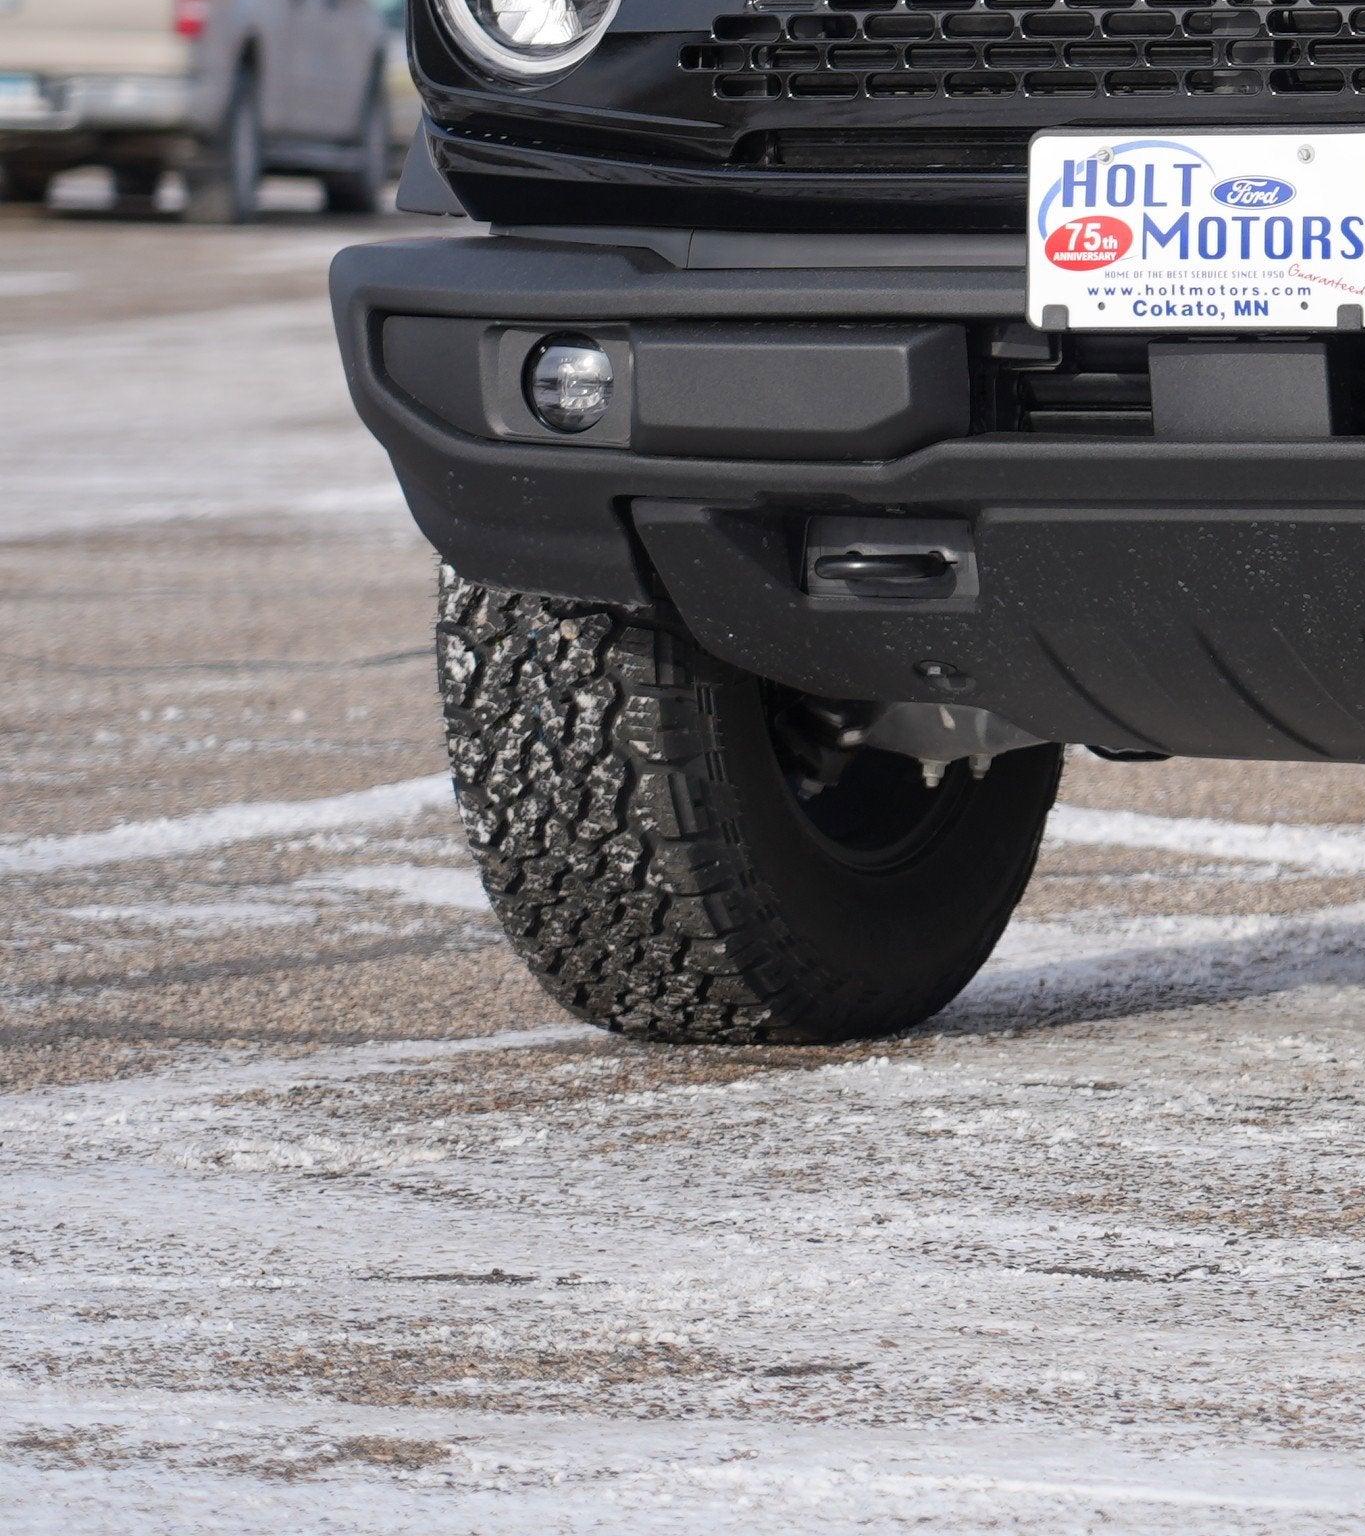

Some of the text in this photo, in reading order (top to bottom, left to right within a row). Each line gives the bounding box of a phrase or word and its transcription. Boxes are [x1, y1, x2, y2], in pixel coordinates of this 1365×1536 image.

[1062, 159, 1202, 208] HOLT
[1226, 179, 1281, 206] Ford
[1065, 222, 1119, 252] 75th
[1142, 211, 1365, 260] MOTORS
[1053, 251, 1118, 262] ANNIVERSARY
[1104, 270, 1285, 279] HOME OF THE BEST SERVICE SINCE 1950
[1087, 284, 1312, 296] www.holtmotors.com
[1132, 299, 1269, 321] Cokato, MN
